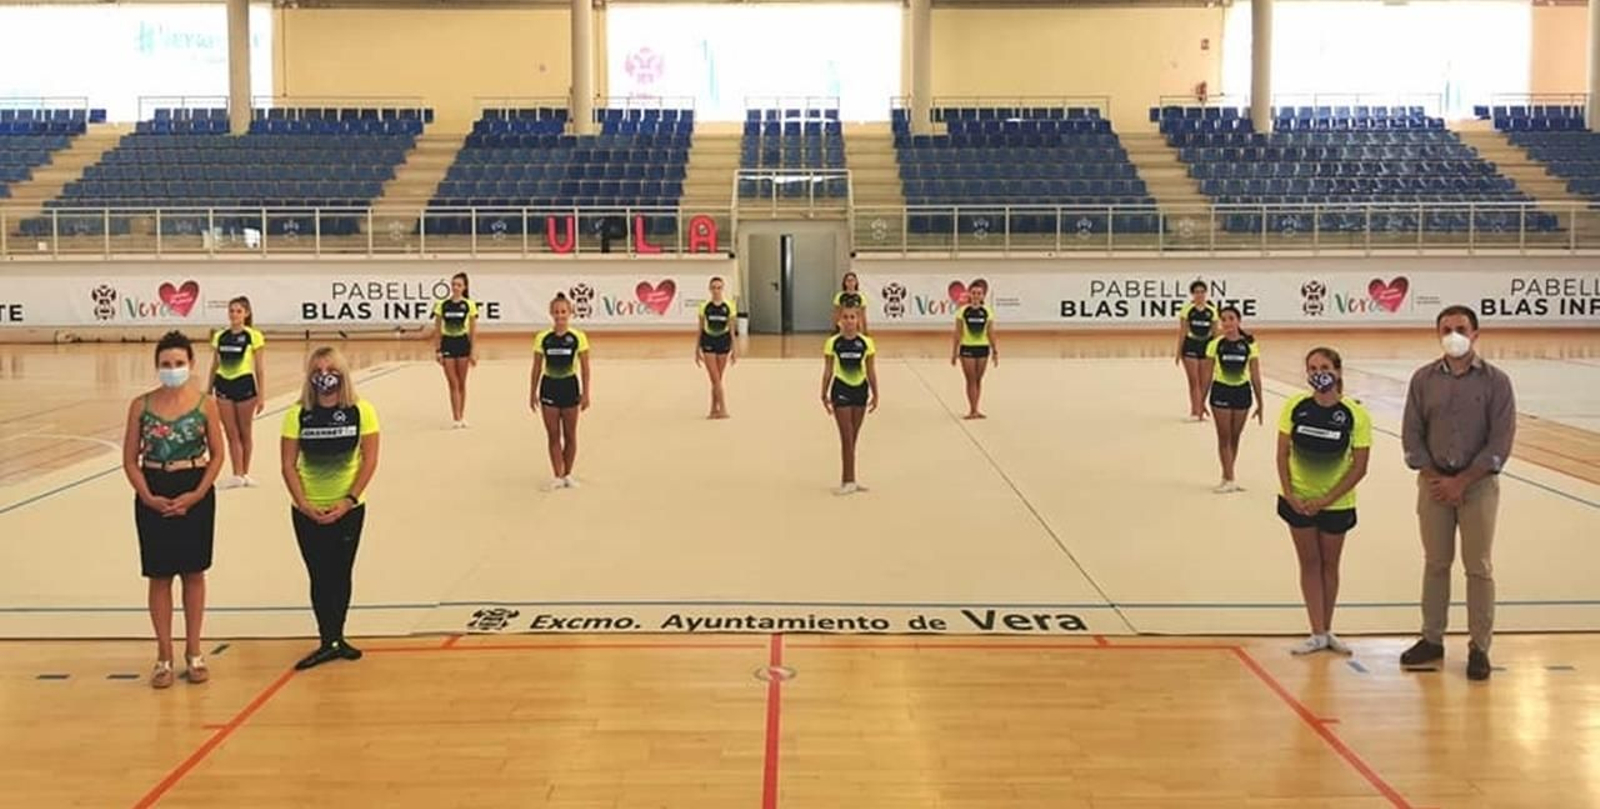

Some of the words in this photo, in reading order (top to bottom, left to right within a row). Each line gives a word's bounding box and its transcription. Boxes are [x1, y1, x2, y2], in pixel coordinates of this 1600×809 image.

[332, 278, 451, 301] PABELLÓ
[1090, 279, 1227, 298] PABELLN
[302, 302, 373, 320] BLAS
[1060, 299, 1129, 317] BLAS
[1481, 298, 1549, 316] BLAS
[529, 613, 642, 630] Excmo.
[660, 613, 890, 632] Ayuntamiento
[908, 615, 948, 631] de
[961, 608, 1087, 632] Vera
